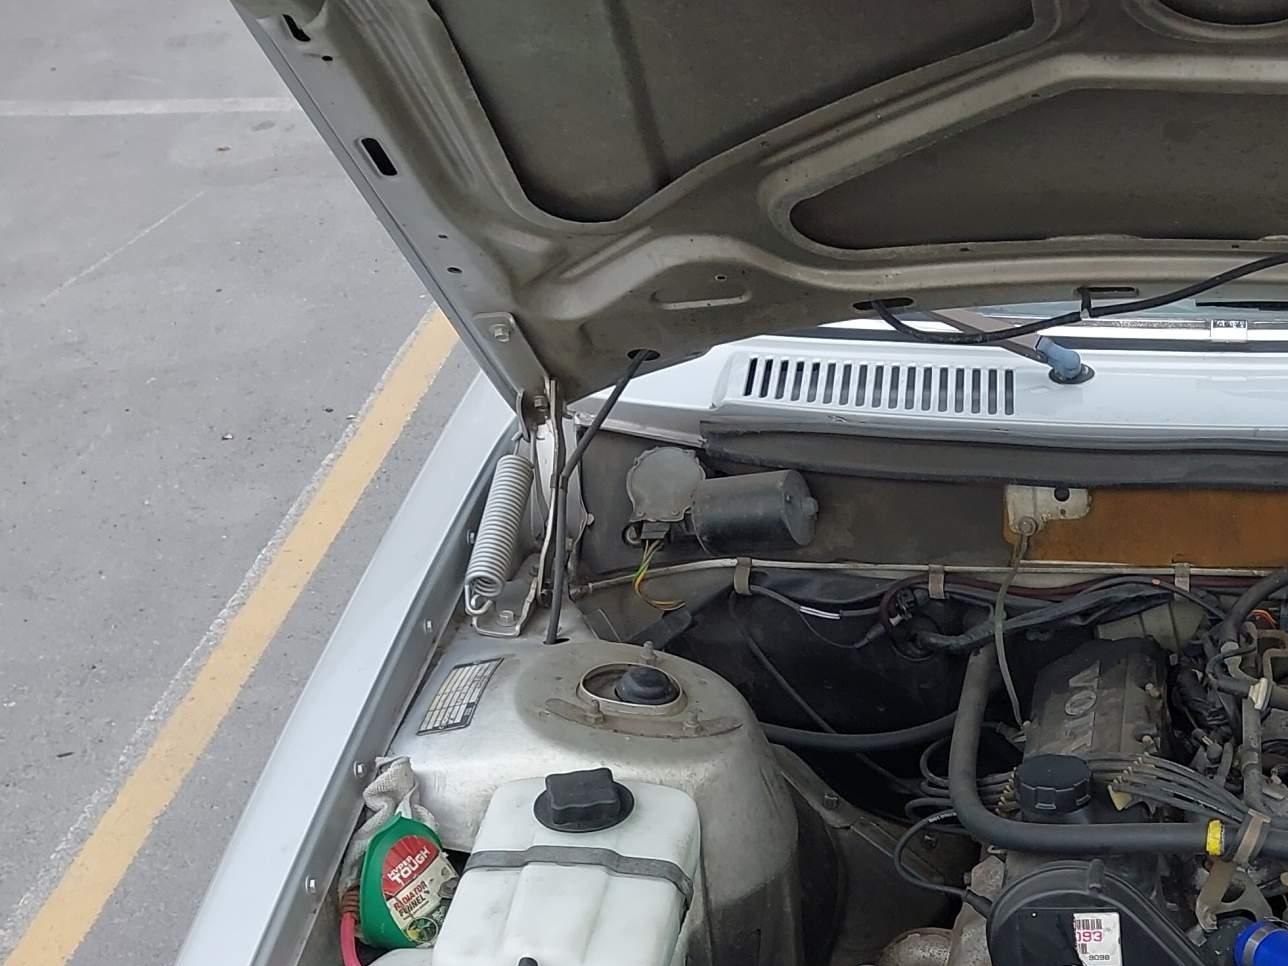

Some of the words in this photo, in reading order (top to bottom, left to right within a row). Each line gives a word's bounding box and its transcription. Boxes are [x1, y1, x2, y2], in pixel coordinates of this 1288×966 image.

[392, 846, 431, 887] TOUGH
[393, 880, 428, 911] RADIATOR
[399, 895, 426, 917] FUNNEL
